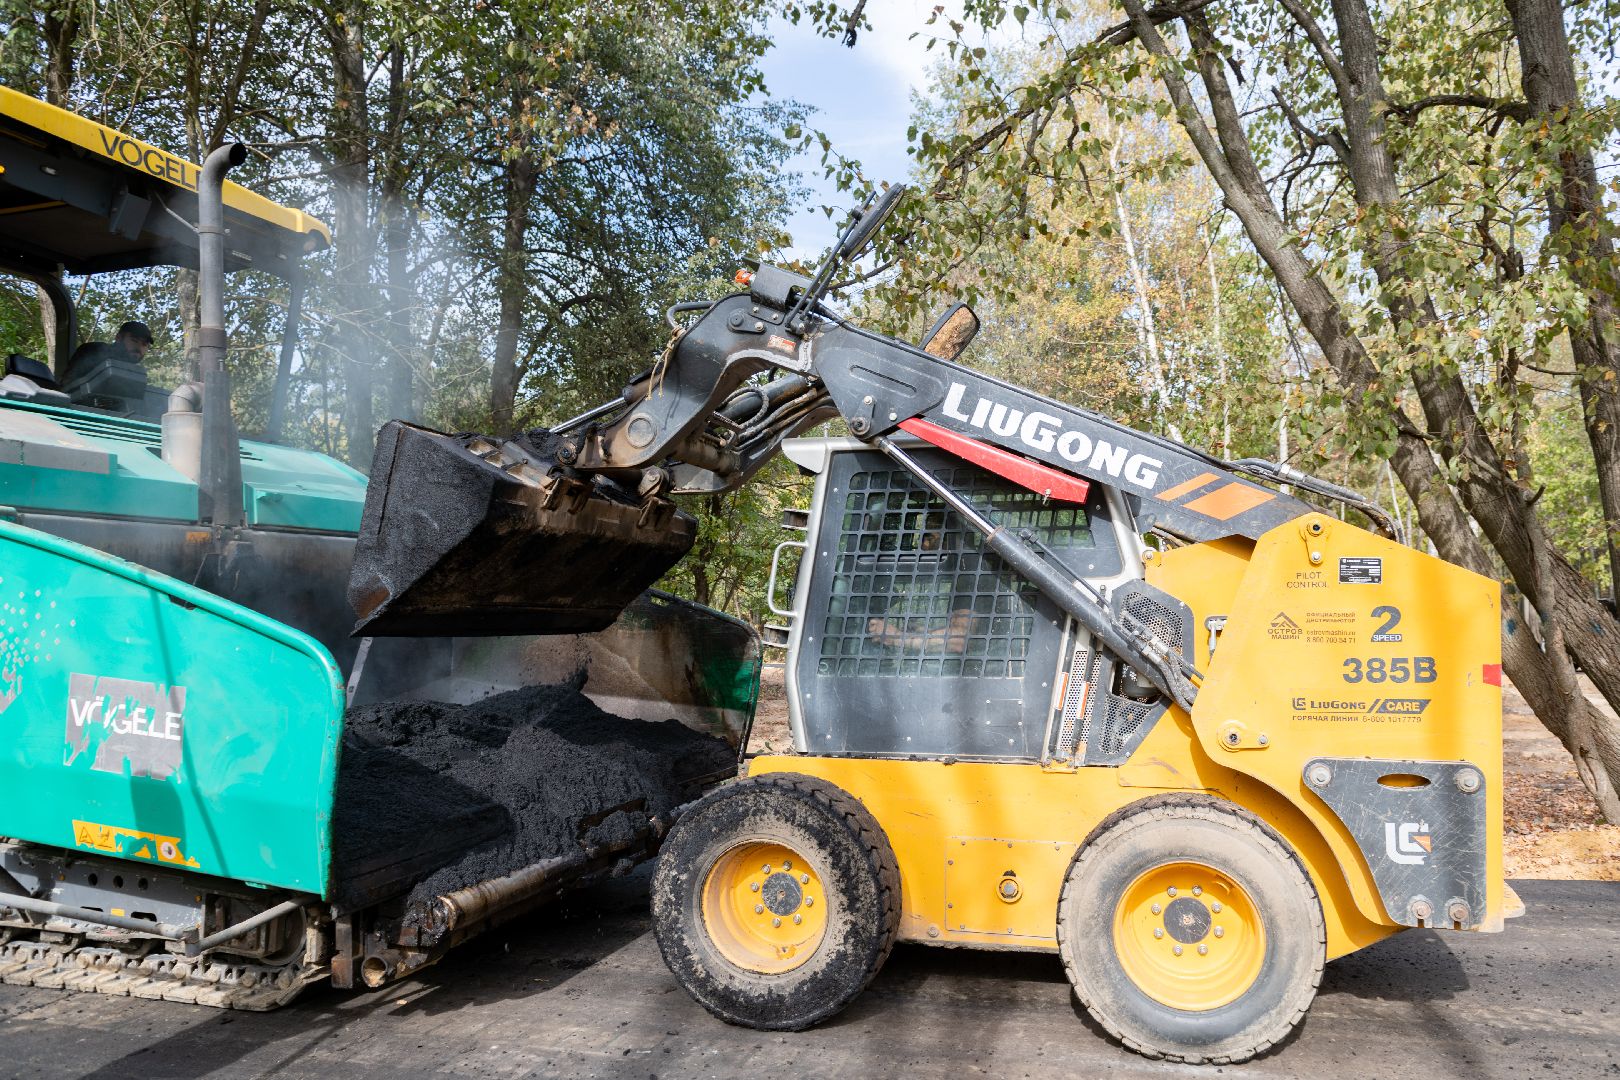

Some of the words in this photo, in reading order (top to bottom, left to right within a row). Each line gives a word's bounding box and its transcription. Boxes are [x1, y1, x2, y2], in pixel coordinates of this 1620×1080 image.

[1296, 571, 1322, 580] PILOT
[1286, 580, 1329, 589] CONTROL
[1371, 606, 1402, 642] 2
[1373, 634, 1402, 642] SPEED
[1342, 656, 1438, 684] 385B
[1386, 701, 1421, 712] CARE
